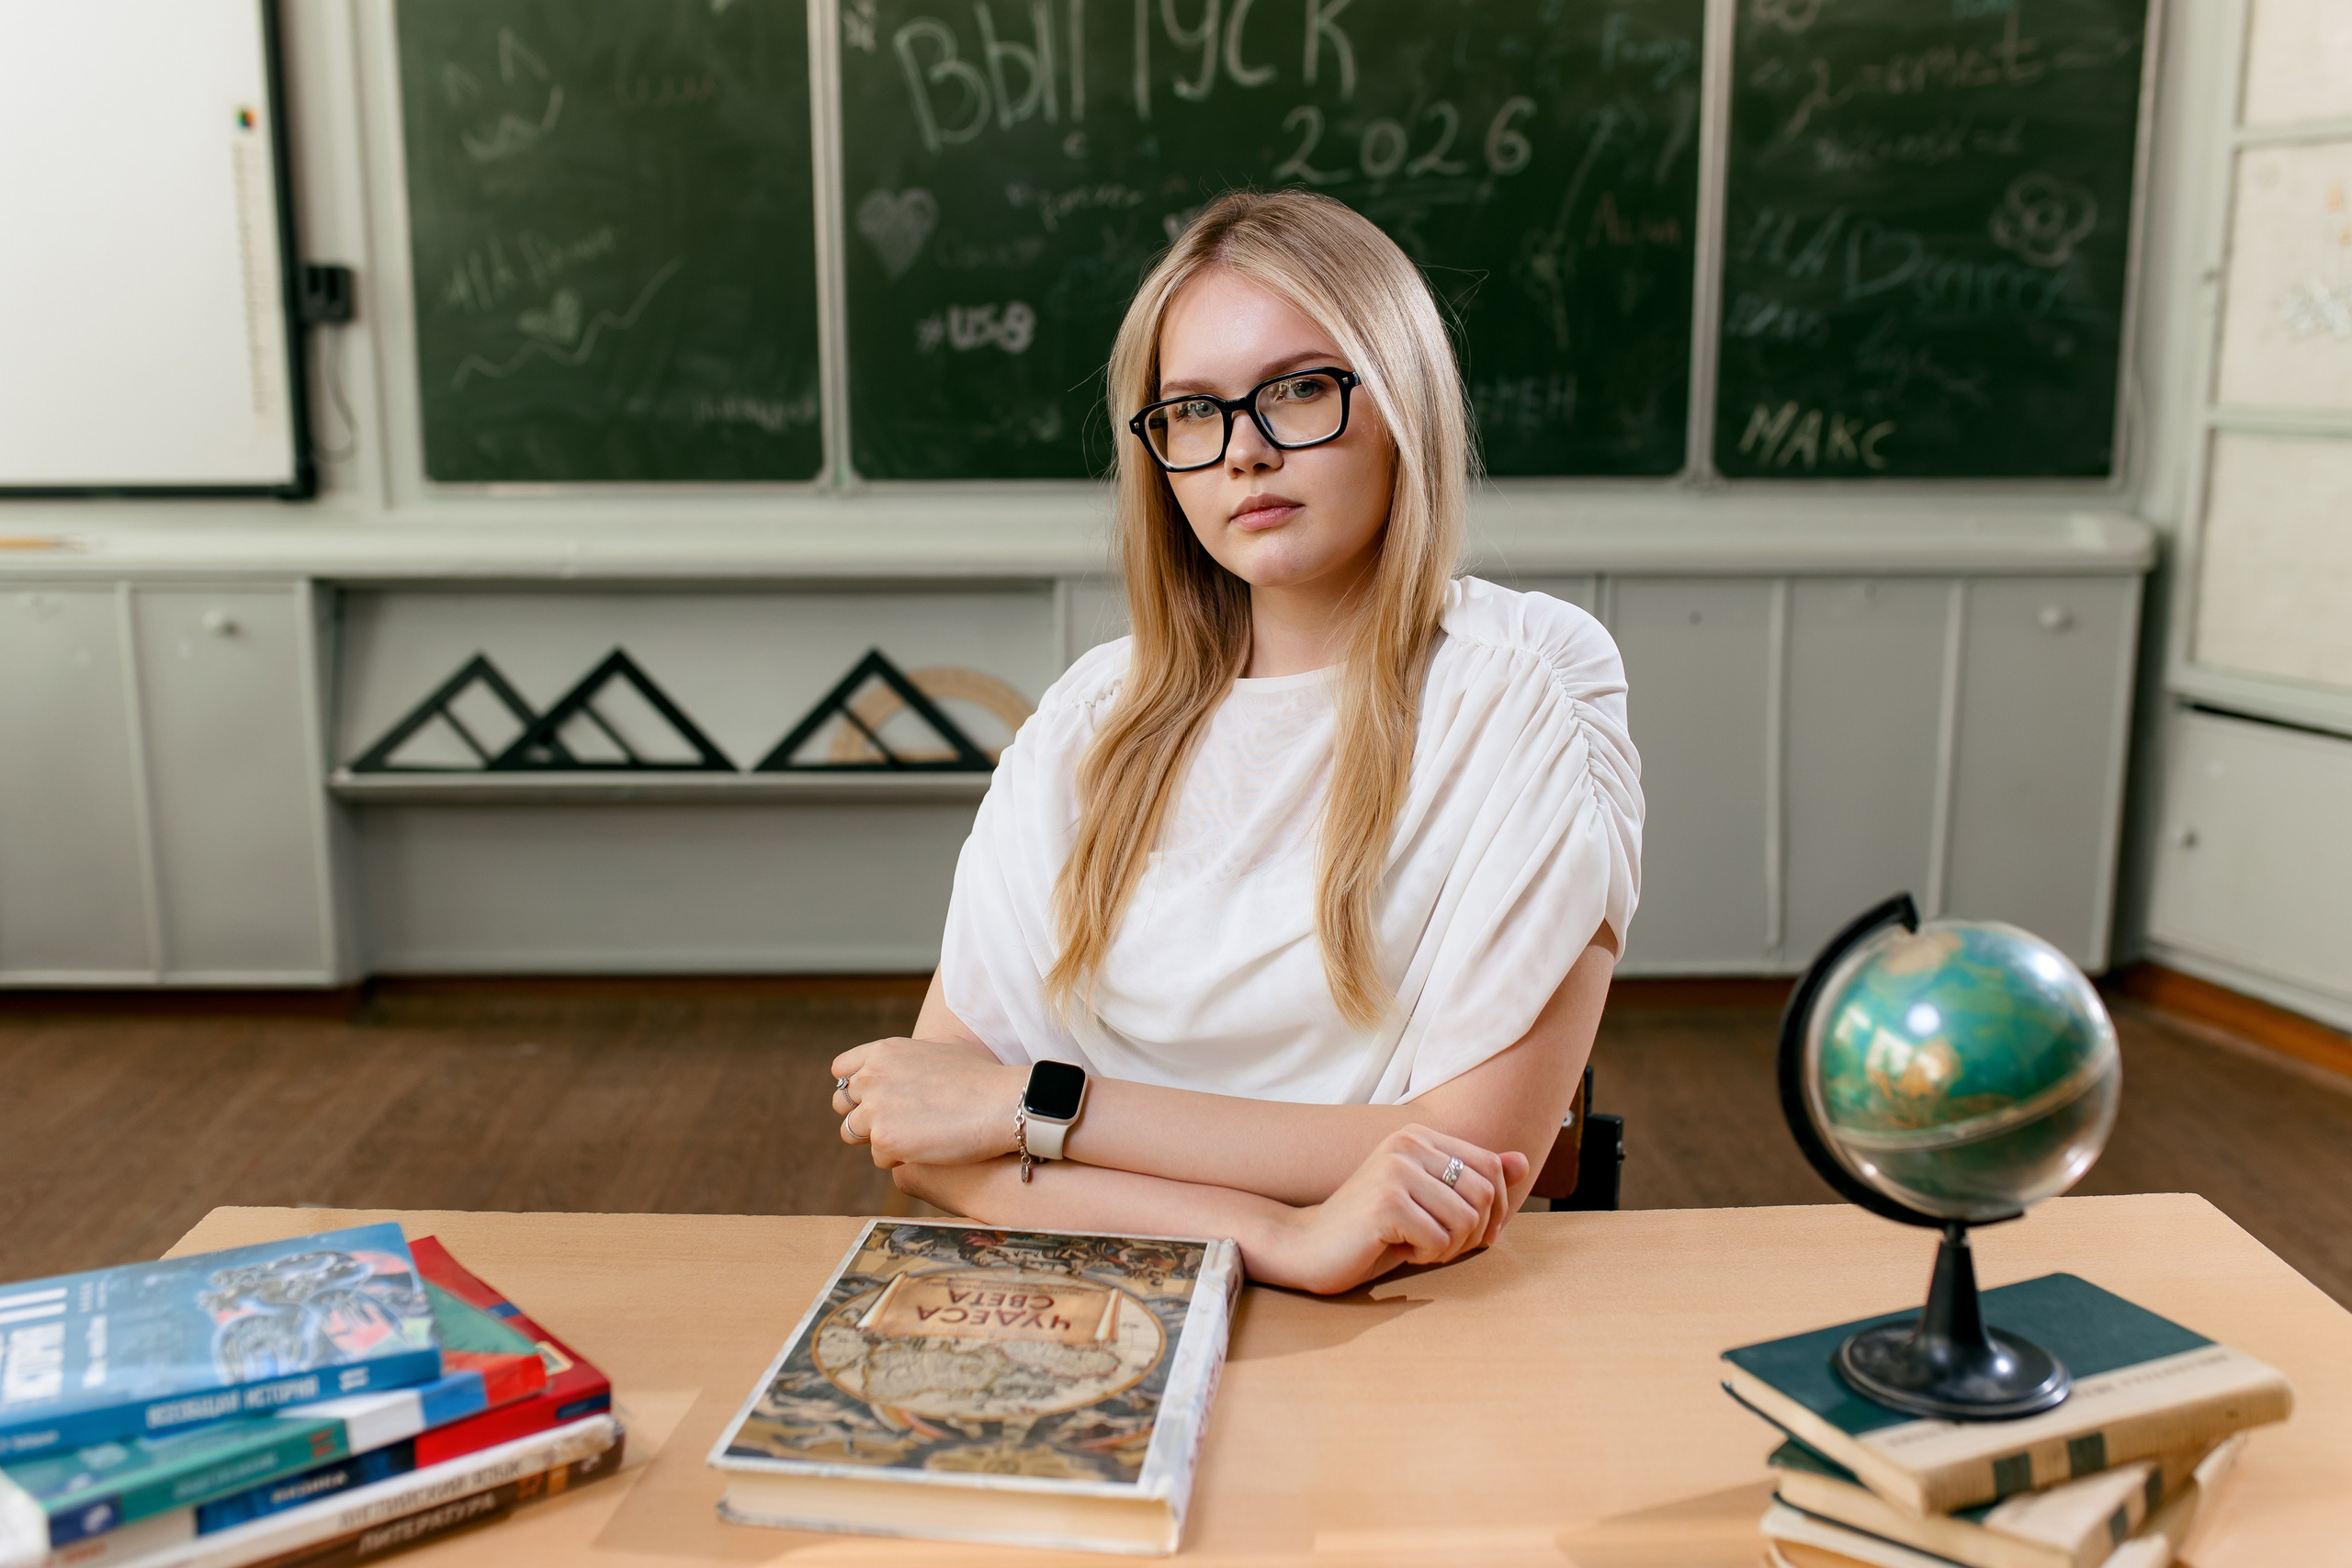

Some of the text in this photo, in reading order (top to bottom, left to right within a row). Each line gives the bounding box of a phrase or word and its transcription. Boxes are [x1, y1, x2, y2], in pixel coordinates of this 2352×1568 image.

[1272, 96, 1538, 182] 2026
[1738, 400, 1898, 470] МАКС
[916, 1304, 1070, 1330] ЧУДЕСА
[949, 1289, 1055, 1311] СВЕТА
[358, 1491, 497, 1556] ЛИТЕРАТУРА
